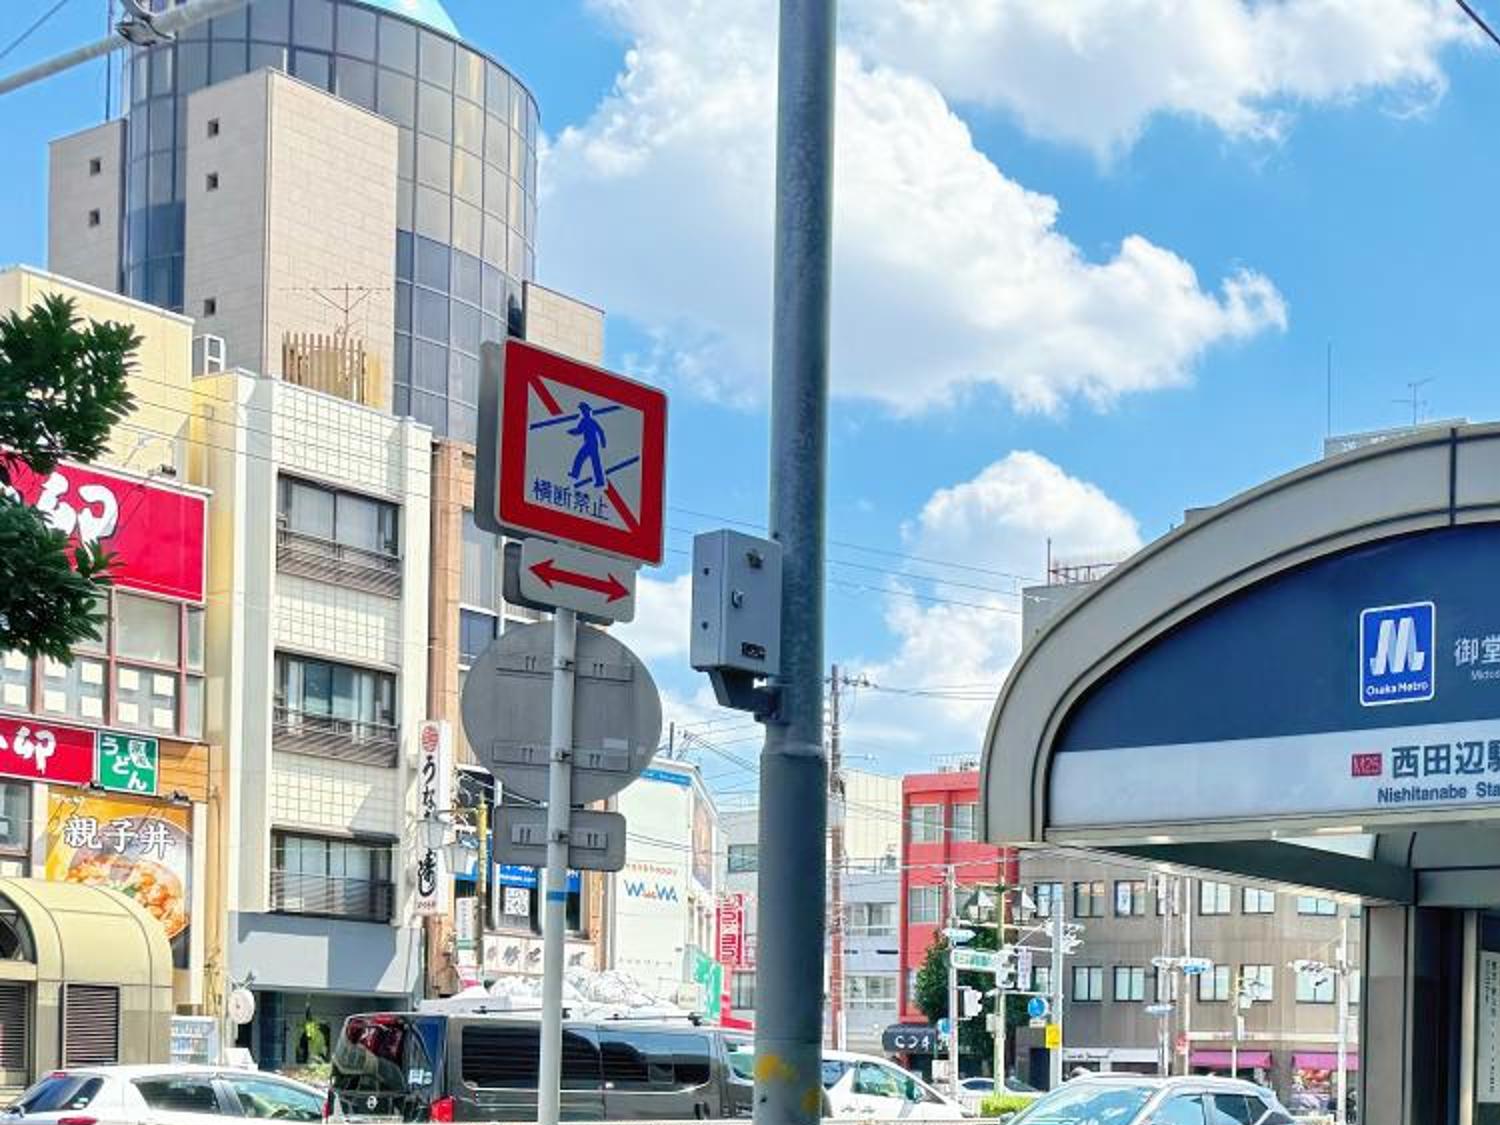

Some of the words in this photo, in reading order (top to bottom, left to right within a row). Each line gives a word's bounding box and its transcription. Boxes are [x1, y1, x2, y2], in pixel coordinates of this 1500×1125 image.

[533, 477, 609, 521] 横断禁止
[1366, 684, 1397, 697] Osaka
[1398, 681, 1430, 693] Metro
[1377, 783, 1467, 804] Nishitanabe
